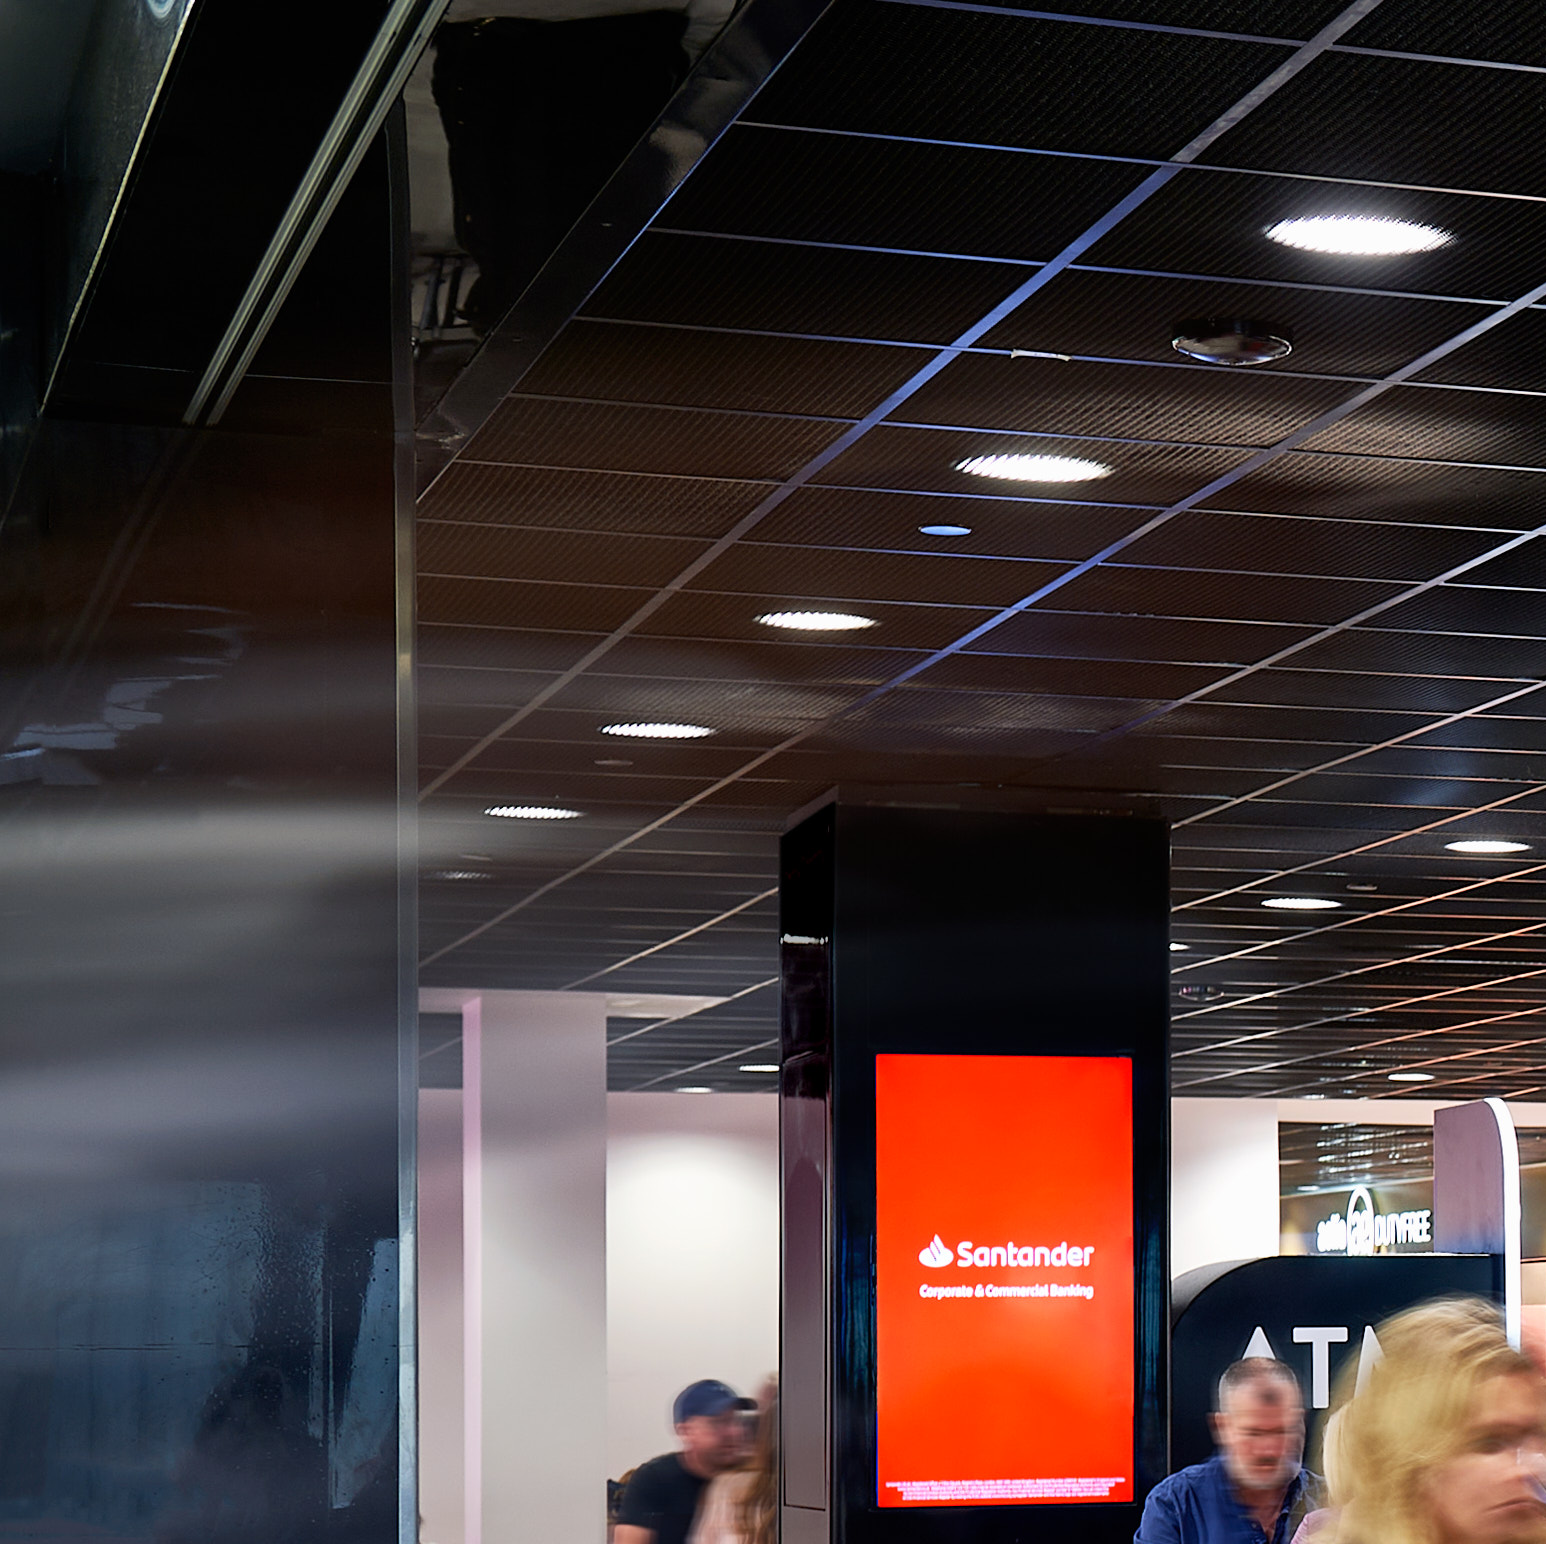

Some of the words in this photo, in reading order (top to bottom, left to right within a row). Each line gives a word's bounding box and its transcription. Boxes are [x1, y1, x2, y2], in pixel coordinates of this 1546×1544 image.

[956, 1241, 1095, 1267] Santander
[919, 1284, 973, 1300] Corporate
[974, 1284, 984, 1298] &
[985, 1284, 1049, 1298] Commercial
[1049, 1284, 1094, 1300] Banking
